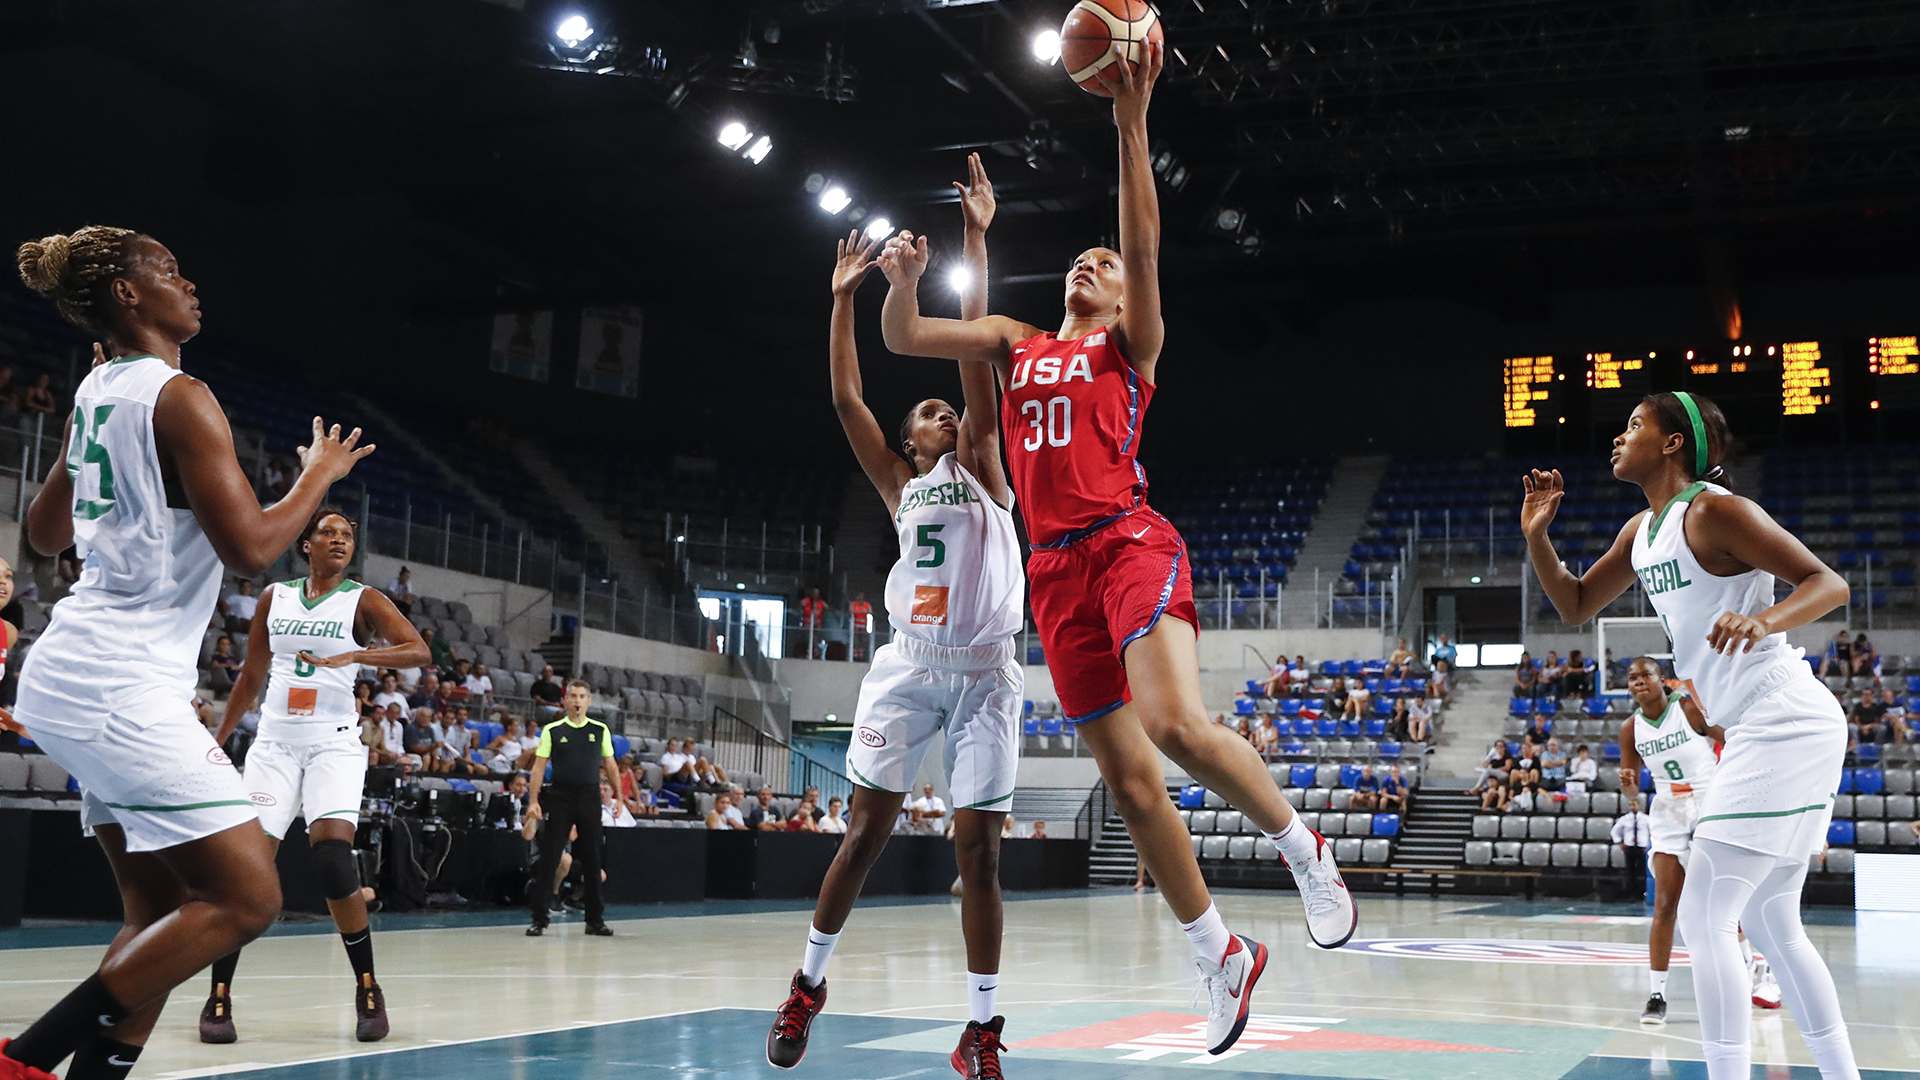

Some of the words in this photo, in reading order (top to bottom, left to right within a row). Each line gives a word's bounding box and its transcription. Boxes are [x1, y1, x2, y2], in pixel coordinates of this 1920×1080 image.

[1010, 353, 1094, 391] USA
[1021, 395, 1072, 452] 30
[916, 524, 946, 568] 5
[270, 618, 345, 639] SENEGAL
[912, 614, 943, 625] orange
[860, 730, 880, 743] sar
[1637, 729, 1691, 758] SENEGAL
[1663, 760, 1684, 780] 8
